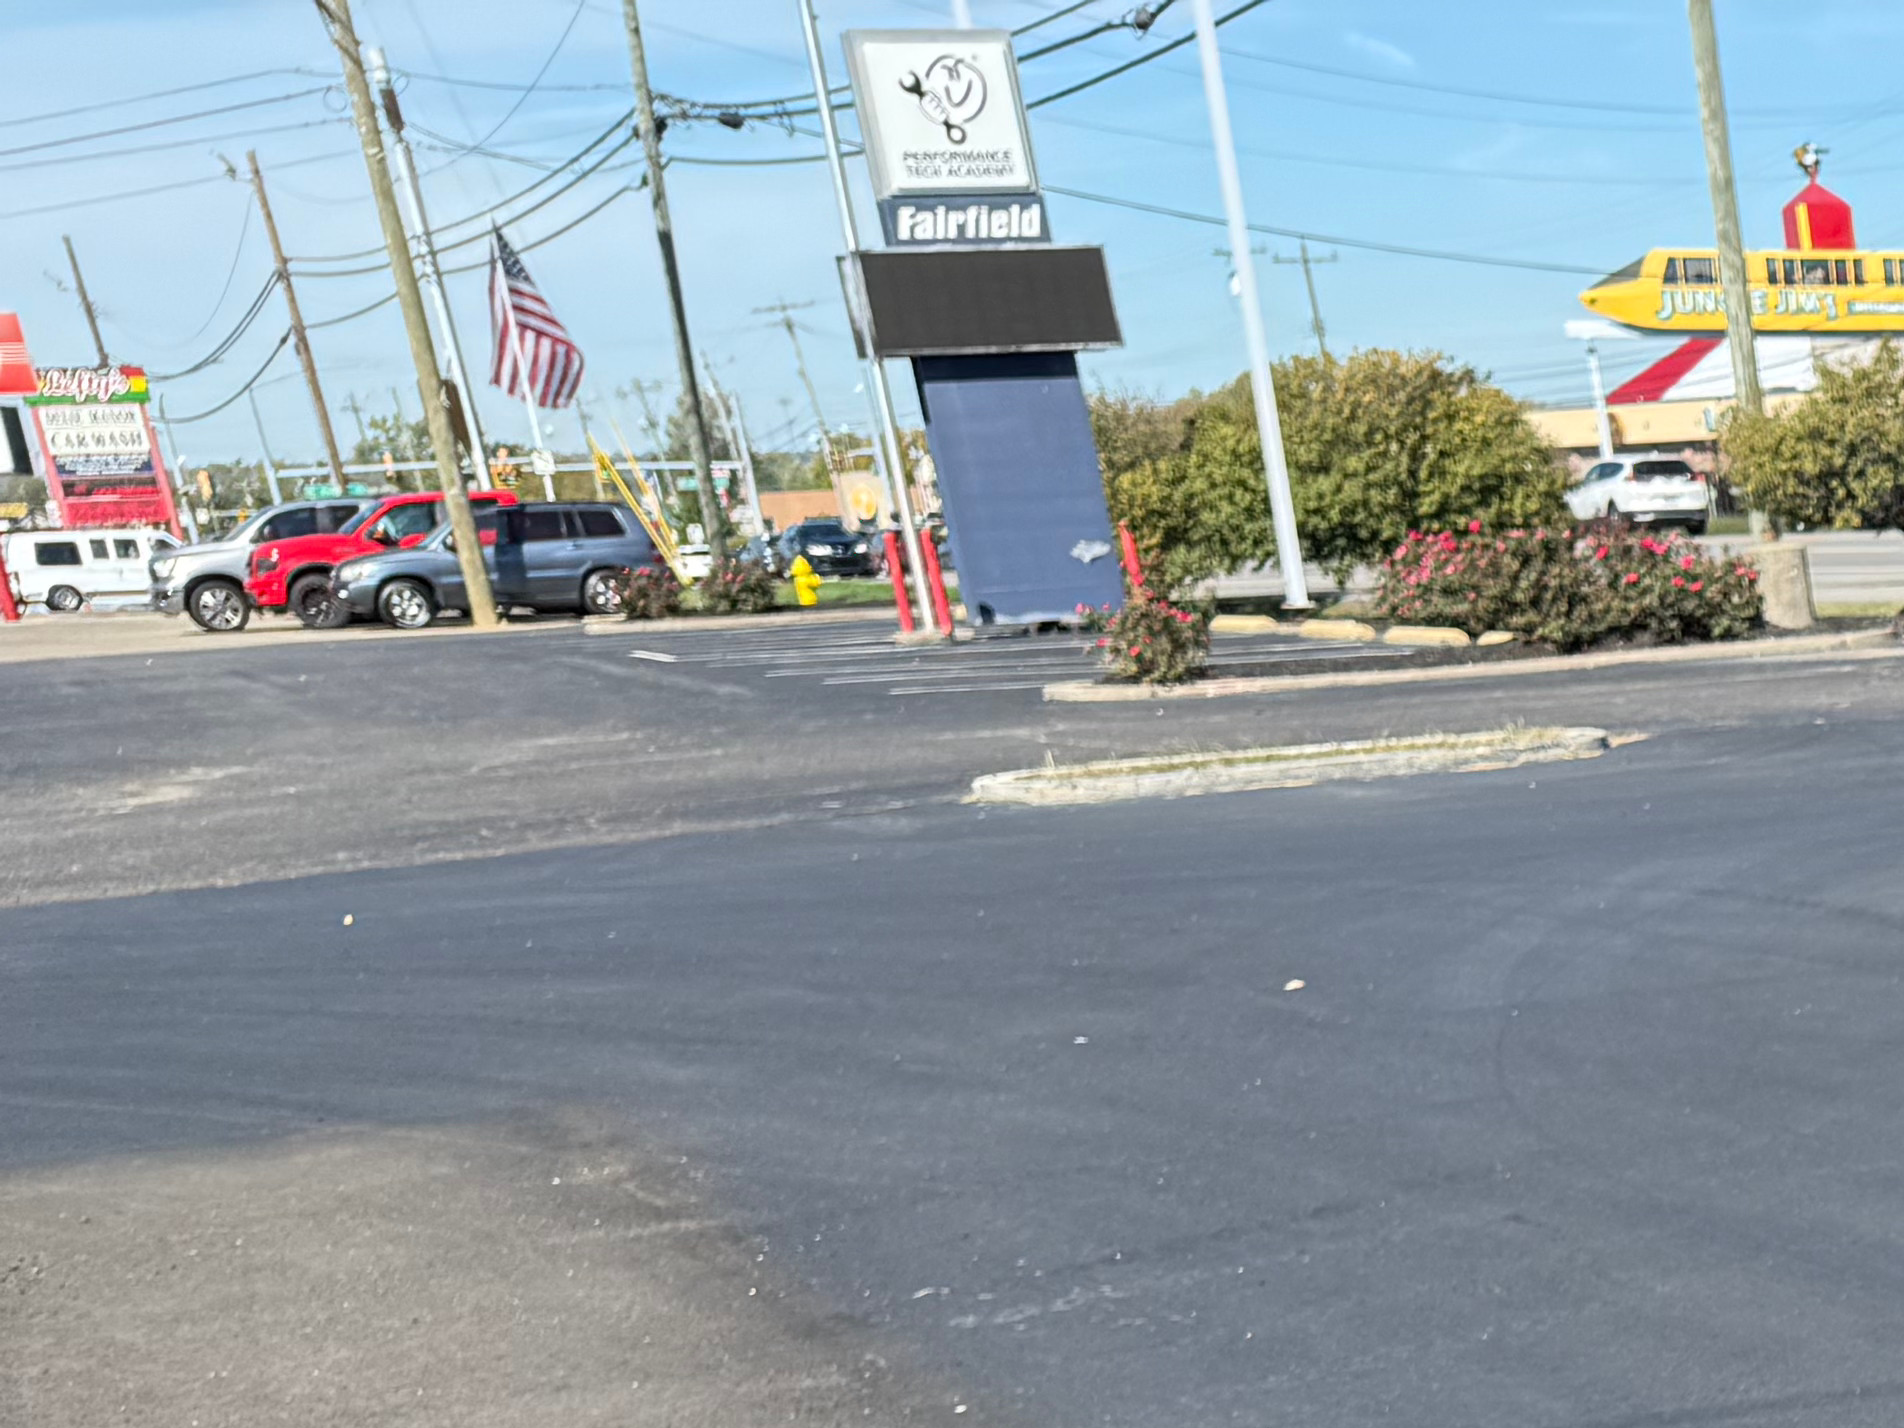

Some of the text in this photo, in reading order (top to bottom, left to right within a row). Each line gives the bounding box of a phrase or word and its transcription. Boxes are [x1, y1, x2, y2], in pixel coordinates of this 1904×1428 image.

[903, 150, 1014, 162] PERFORMANCE
[907, 163, 1015, 178] TECH ACADEMY
[898, 203, 1041, 240] Fairfield
[1656, 288, 1769, 320] JUNE
